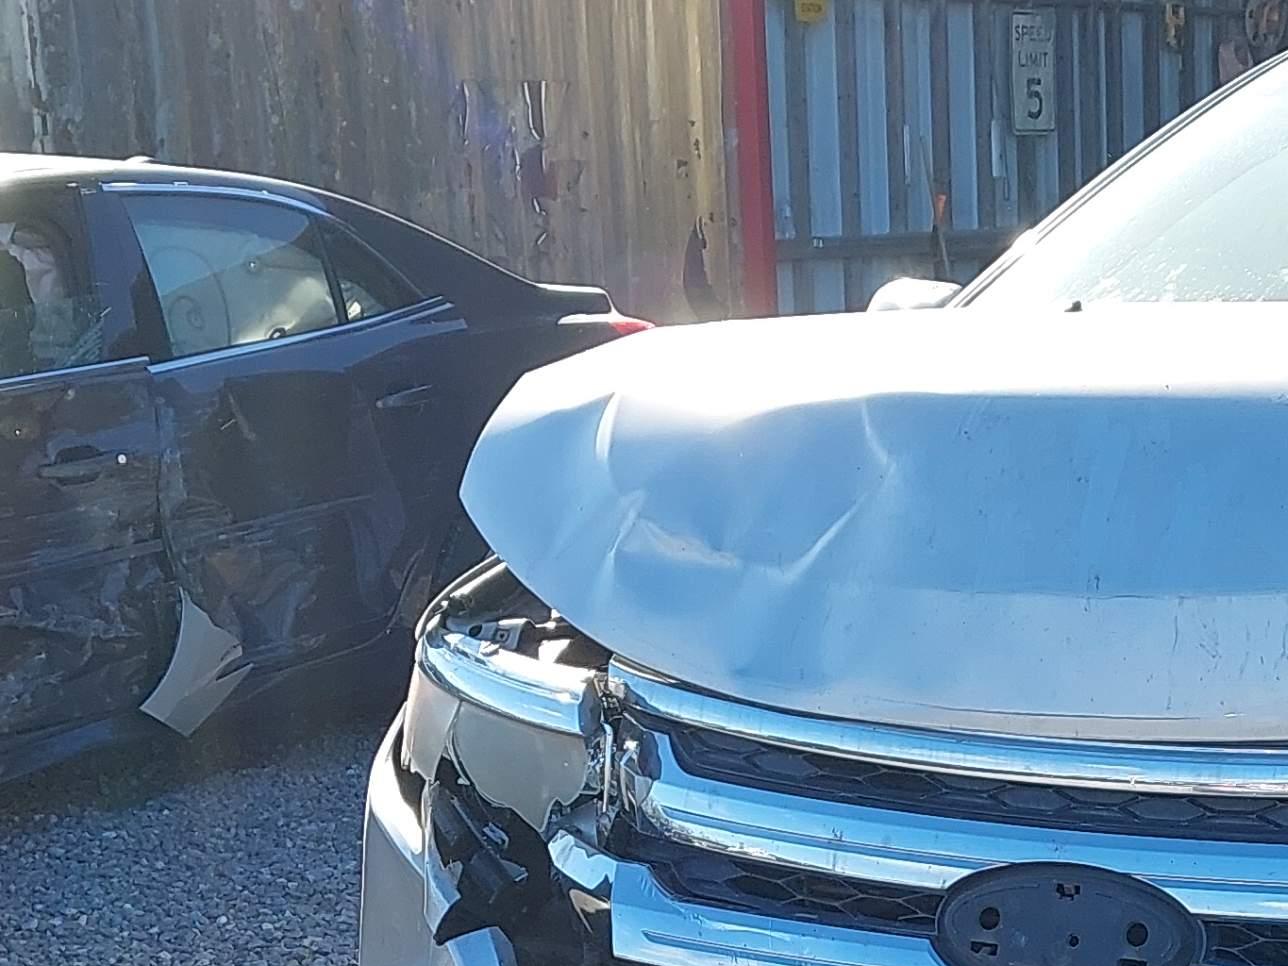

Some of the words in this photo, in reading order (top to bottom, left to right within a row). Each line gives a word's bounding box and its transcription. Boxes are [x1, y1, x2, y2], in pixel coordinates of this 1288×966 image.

[1014, 24, 1052, 42] SPEED
[1018, 50, 1049, 68] LIMIT
[1026, 77, 1043, 120] 5
